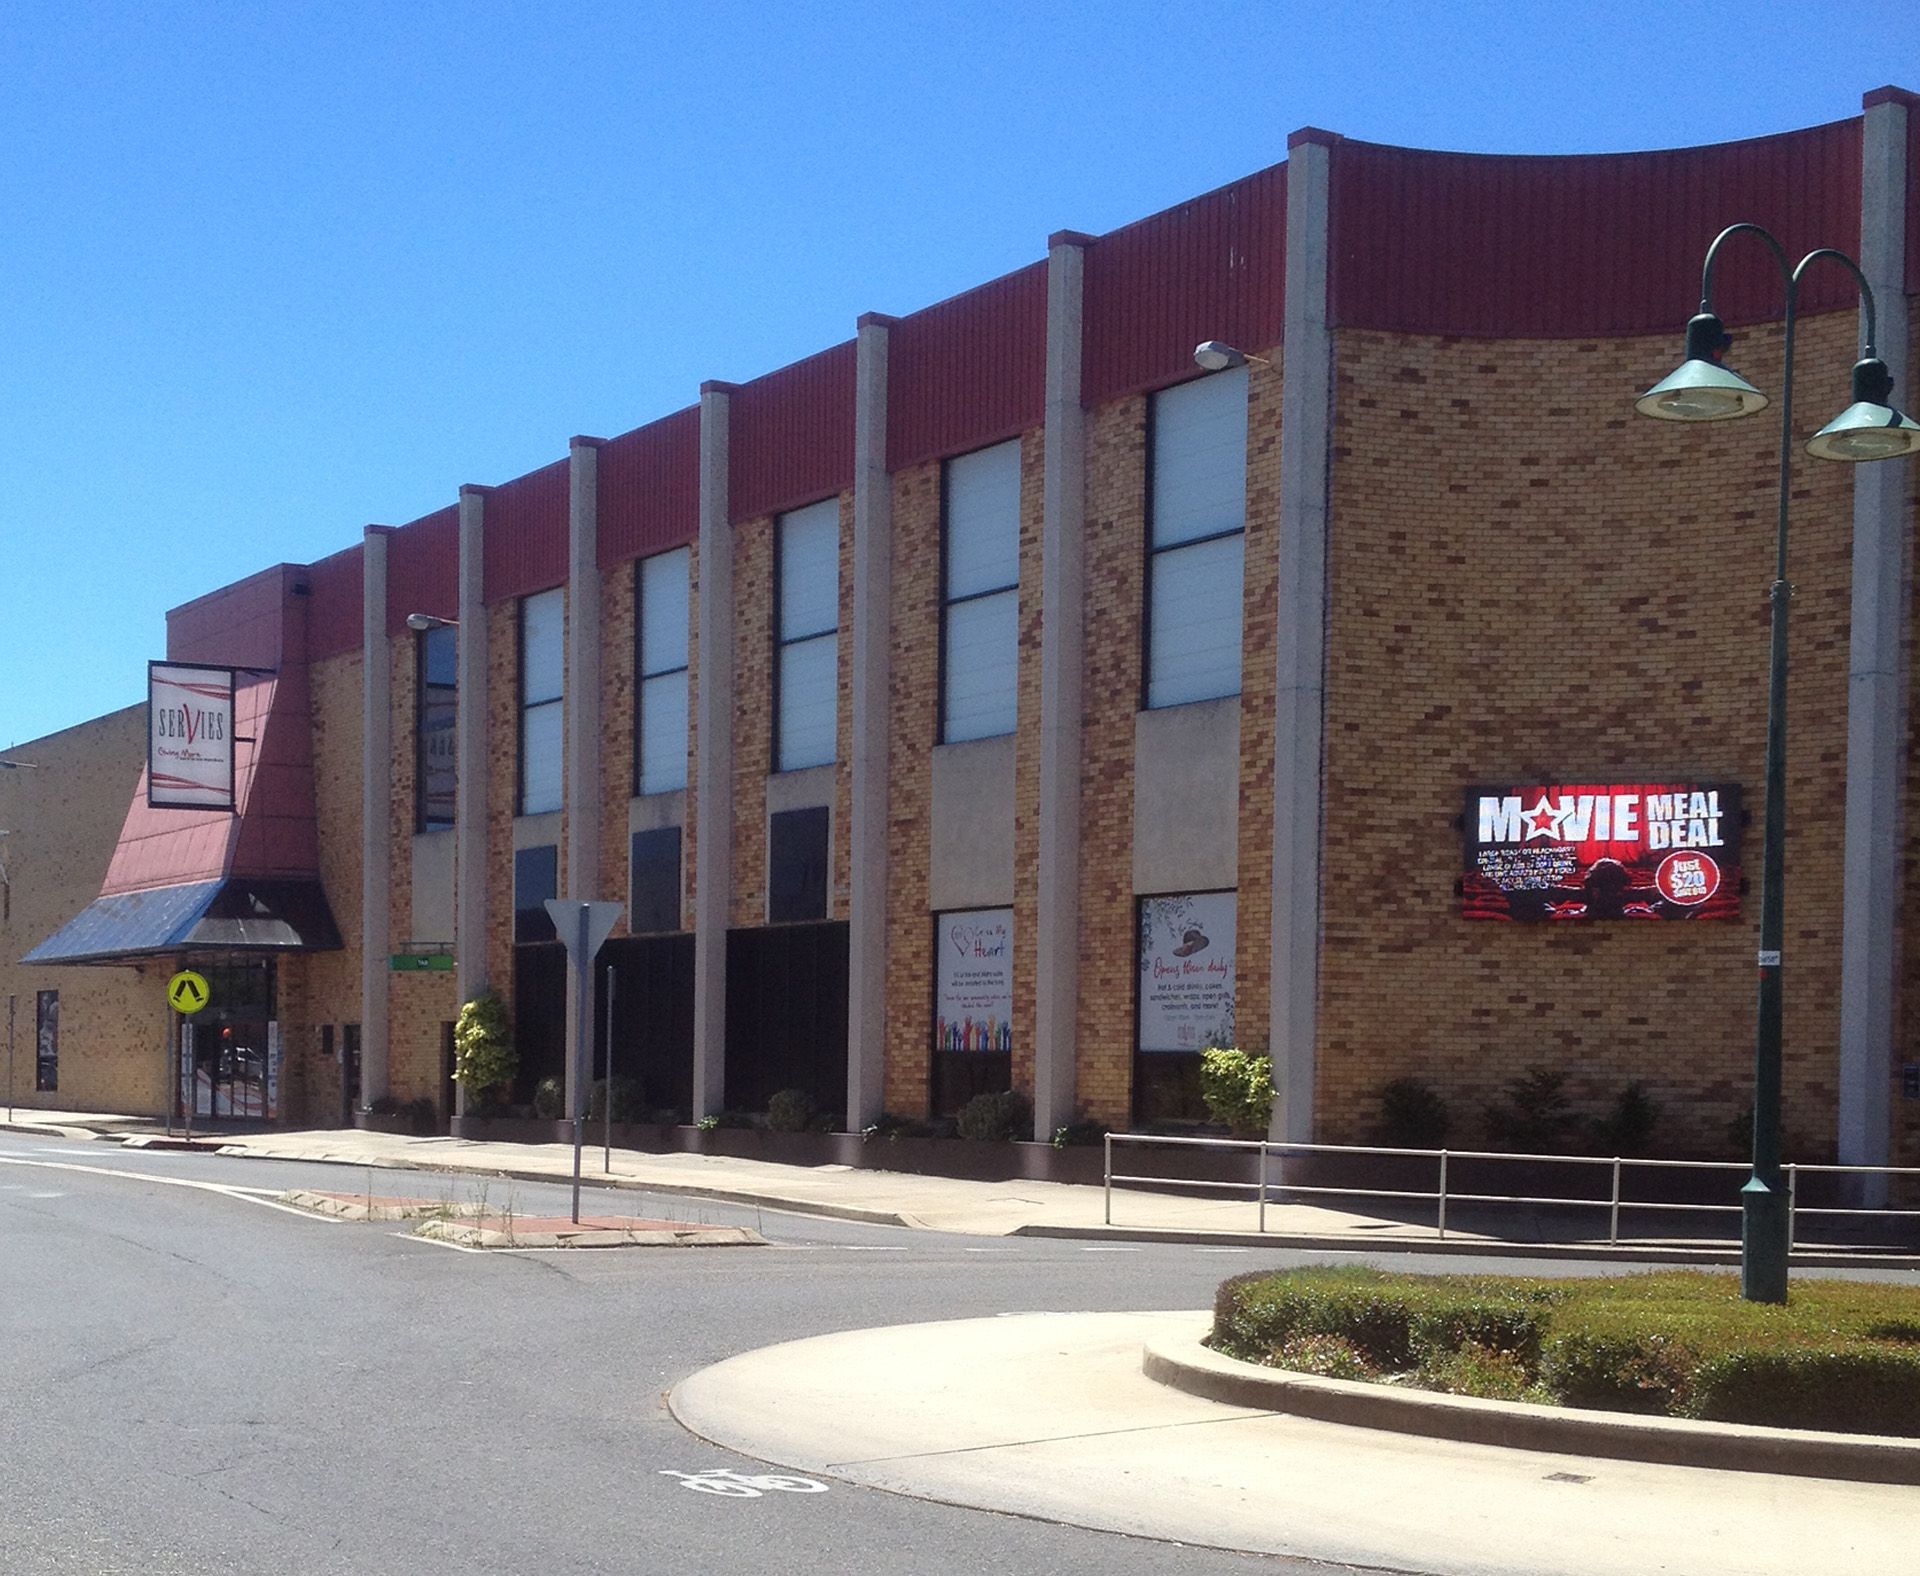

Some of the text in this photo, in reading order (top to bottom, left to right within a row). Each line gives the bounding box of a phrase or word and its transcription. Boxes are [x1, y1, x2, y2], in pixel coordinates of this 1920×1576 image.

[159, 703, 223, 745] SERVIES
[1647, 791, 1723, 820] MEAL
[1648, 819, 1724, 850] DEAL
[1670, 870, 1706, 889] $20
[974, 938, 1005, 958] Heart
